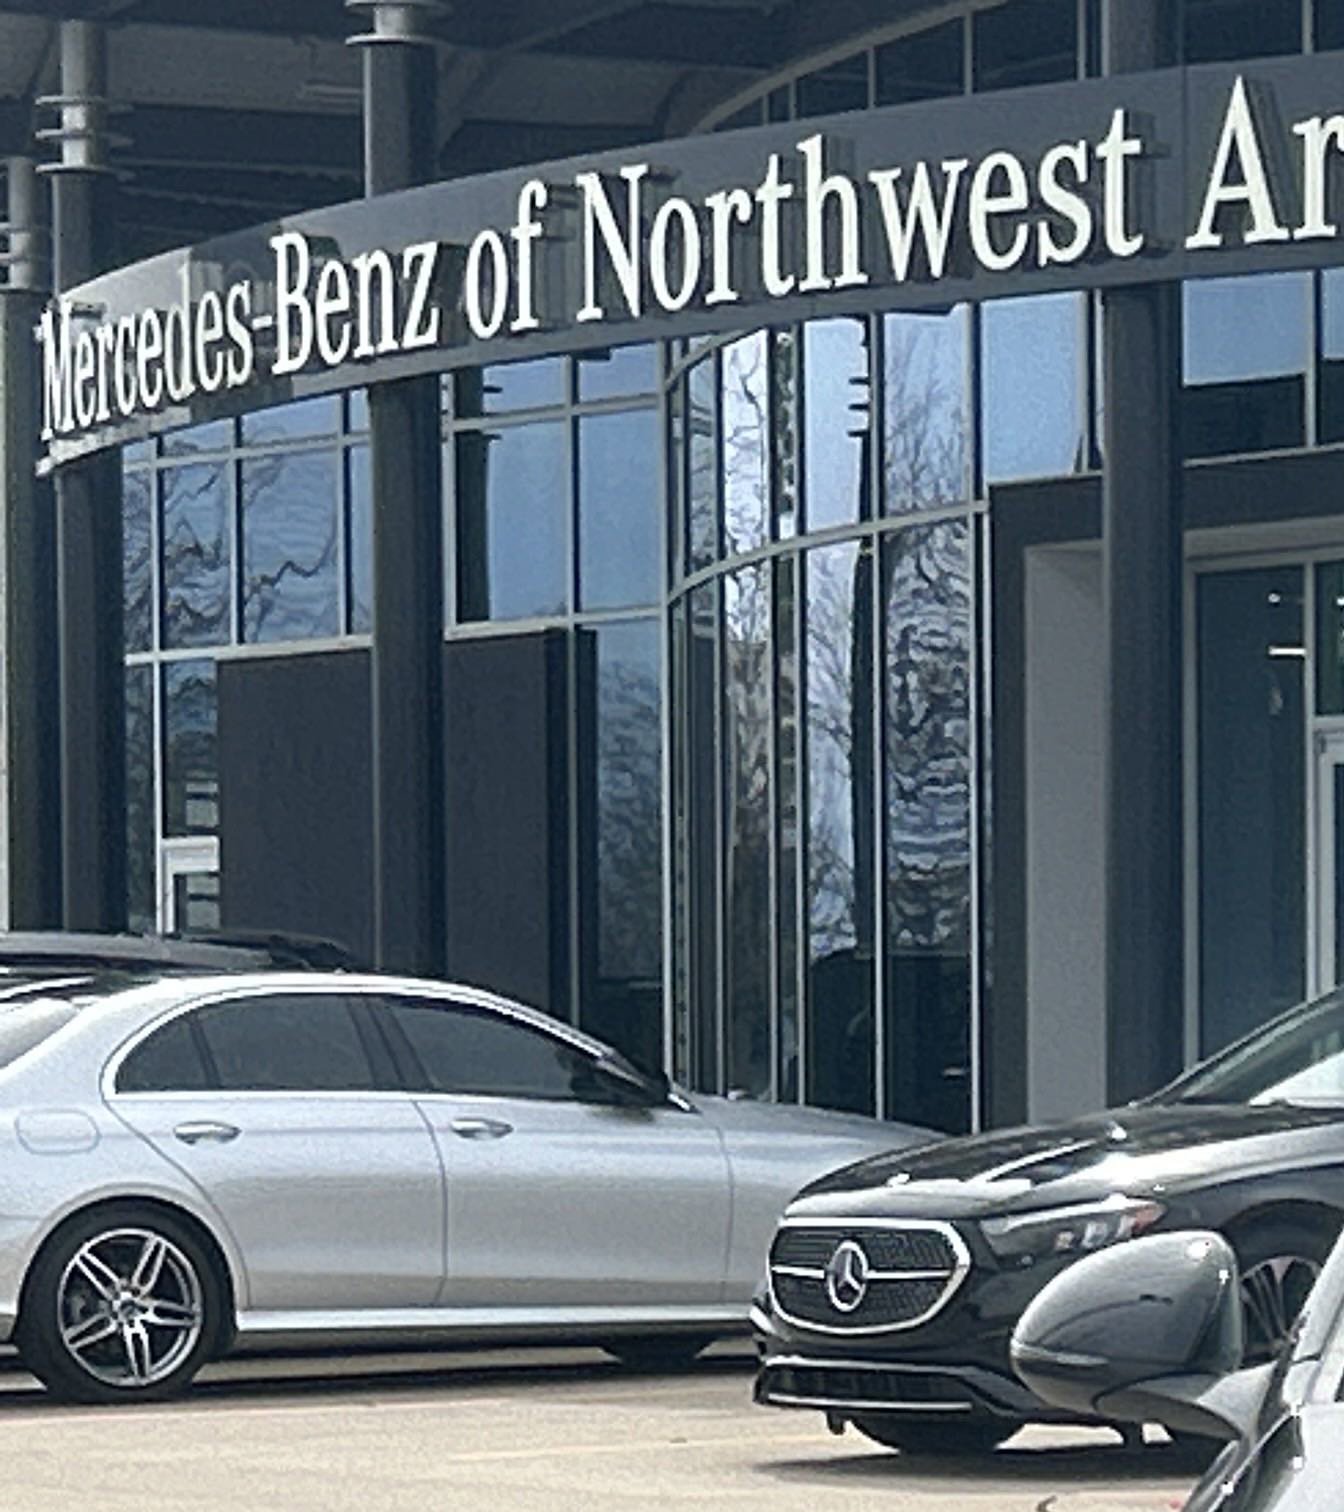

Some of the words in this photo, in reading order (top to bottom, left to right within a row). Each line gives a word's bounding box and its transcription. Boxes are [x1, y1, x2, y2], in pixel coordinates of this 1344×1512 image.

[36, 230, 439, 440] Mercedes-Benz
[465, 180, 547, 339] of
[576, 108, 1144, 322] Northwest
